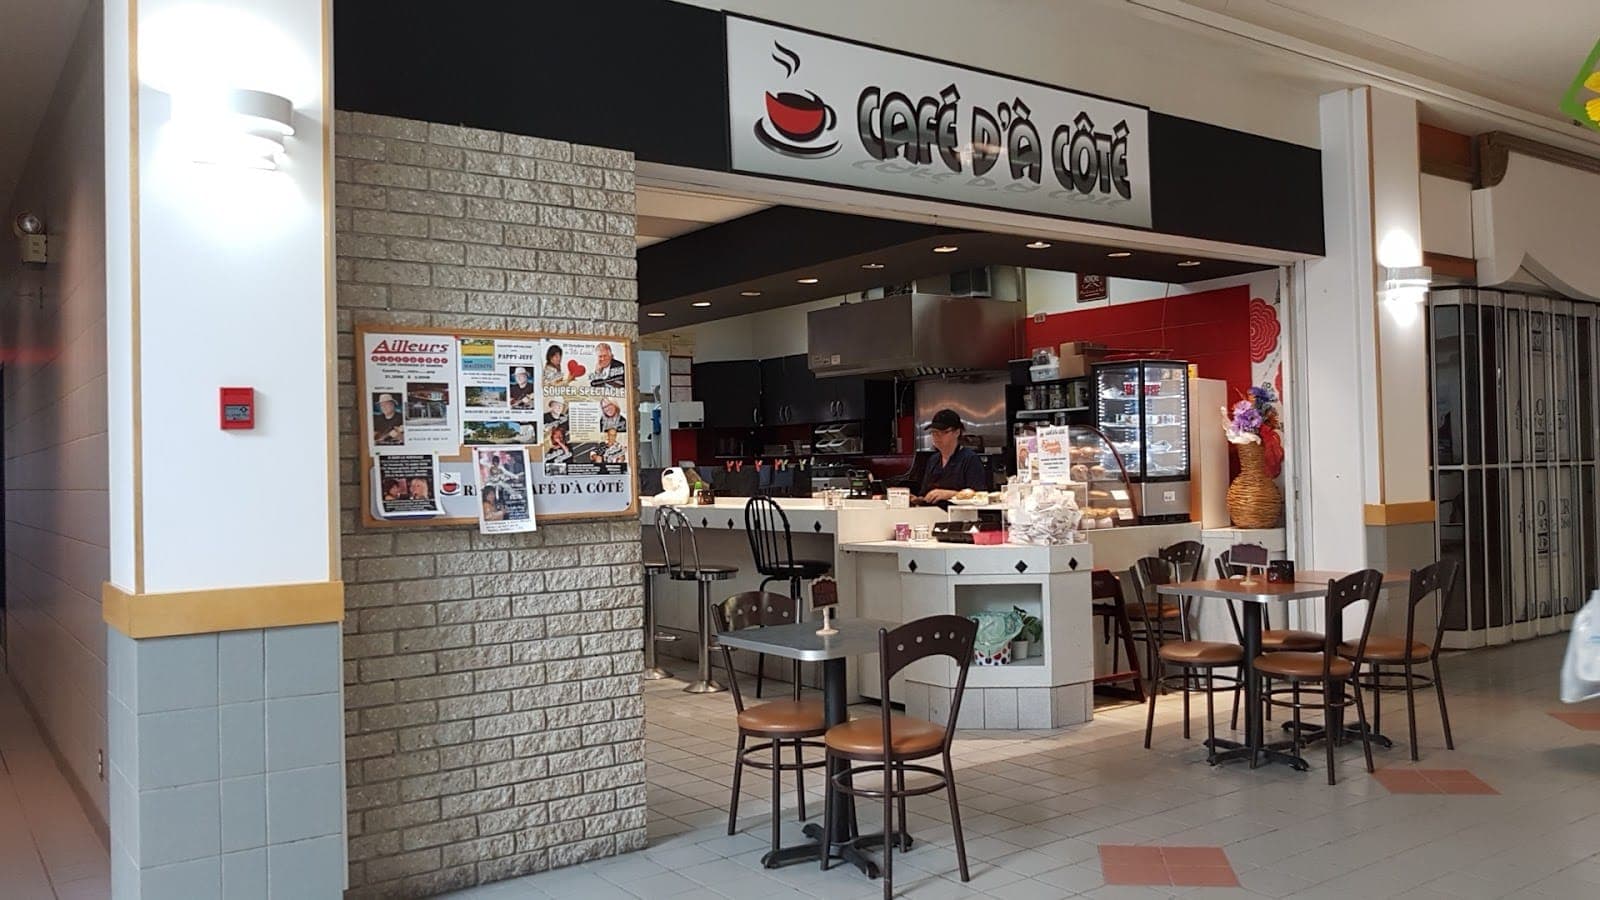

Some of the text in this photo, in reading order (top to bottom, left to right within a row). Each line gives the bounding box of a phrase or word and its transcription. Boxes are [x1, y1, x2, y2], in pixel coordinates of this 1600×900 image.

[856, 83, 1132, 200] CAFÉ D'À CÔTÉ
[371, 339, 449, 354] Ailleurs
[543, 385, 625, 398] SOUPER SPECTACLE
[532, 481, 557, 495] AFÉ
[561, 480, 582, 495] D'À
[586, 479, 624, 494] CÔTÉ
